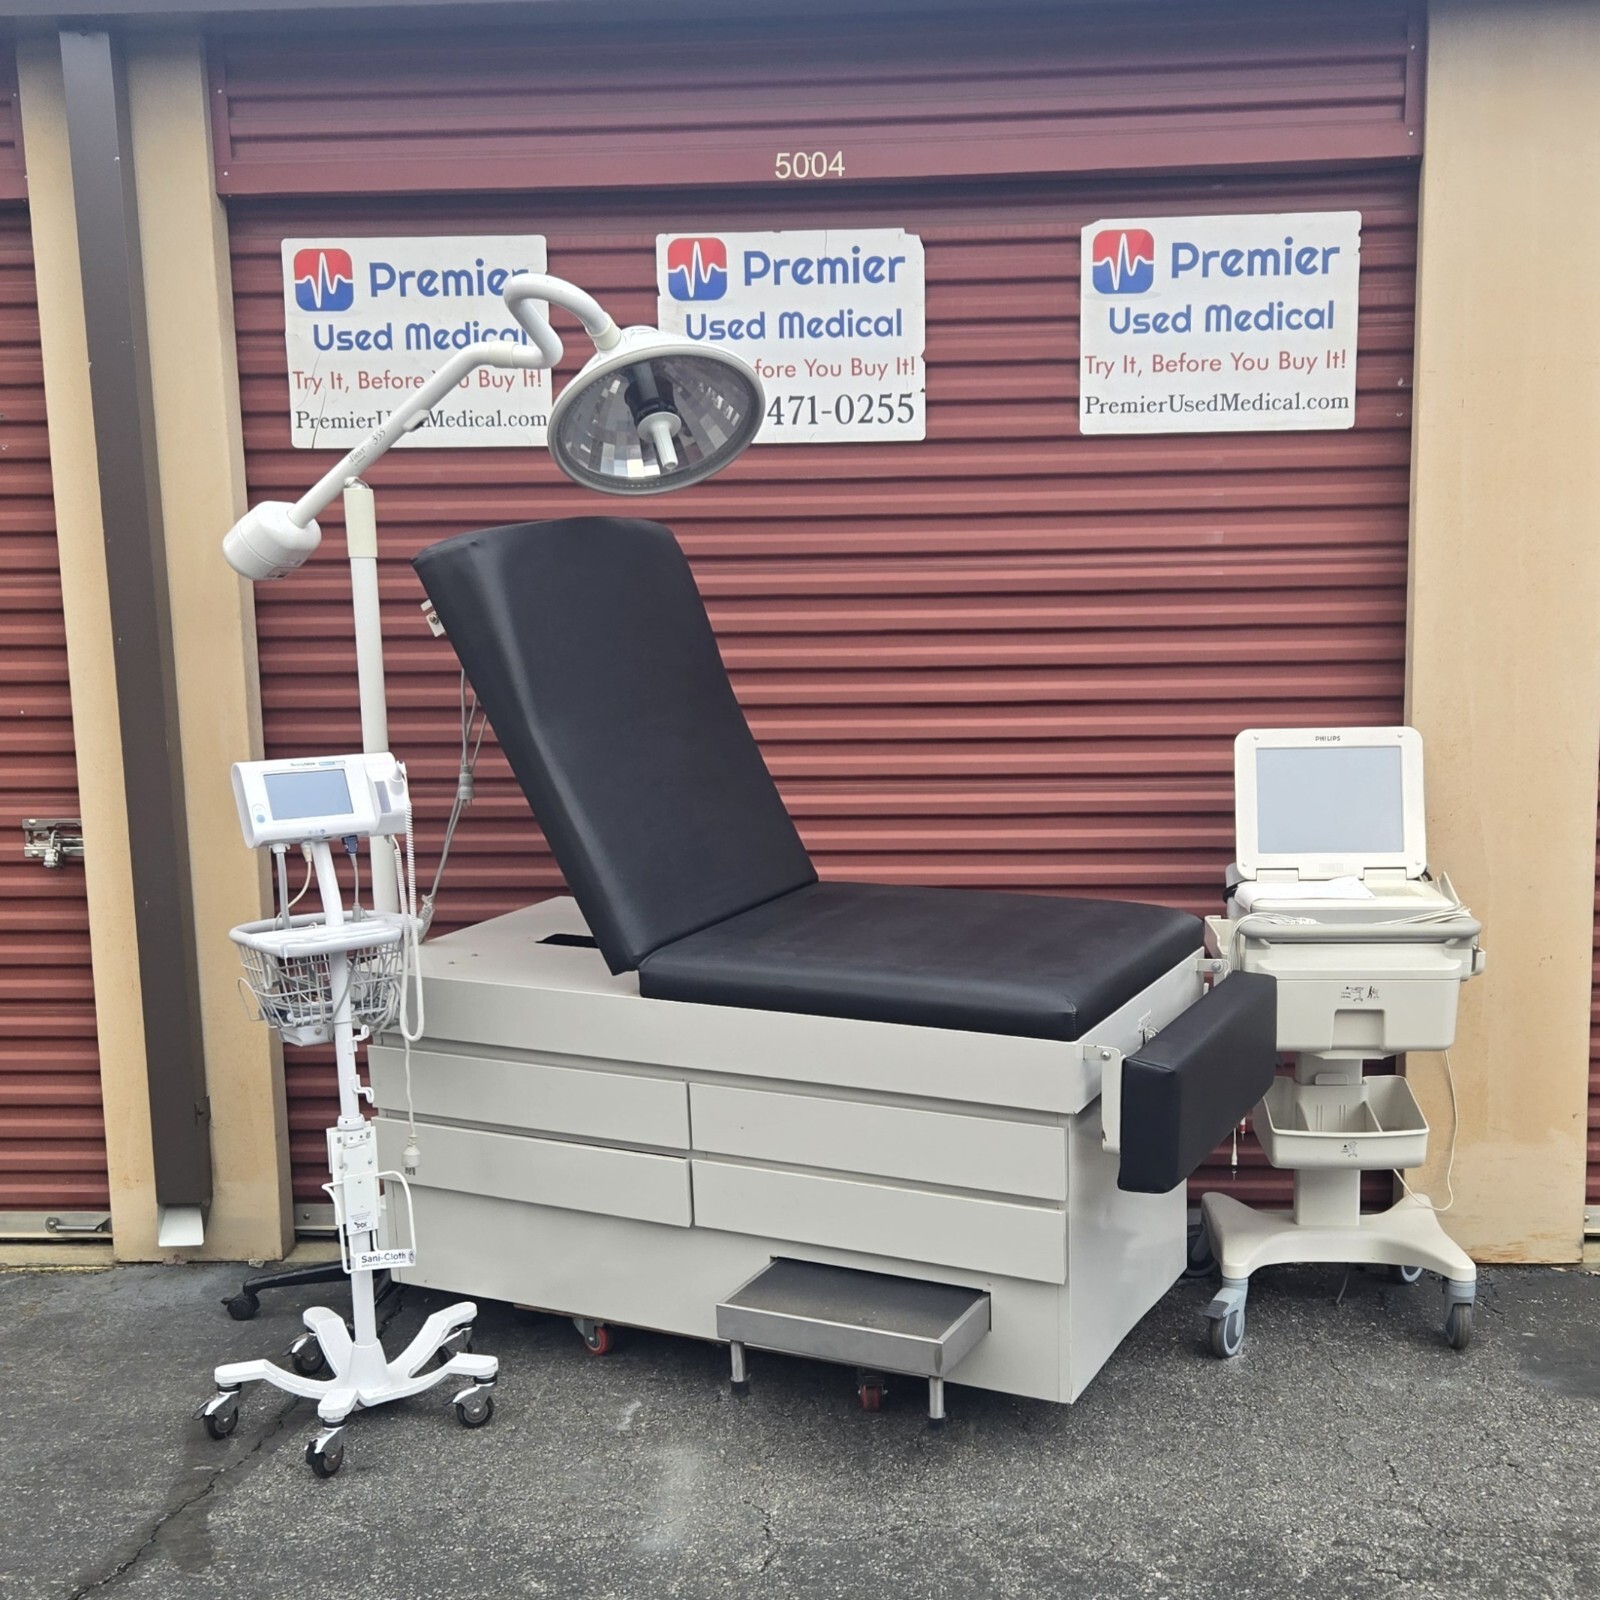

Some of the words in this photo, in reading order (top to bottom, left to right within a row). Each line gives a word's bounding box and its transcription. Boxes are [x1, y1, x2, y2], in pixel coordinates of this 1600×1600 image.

[775, 151, 845, 179] 5004
[744, 245, 905, 286] Premier
[1171, 236, 1340, 279] Premier
[686, 311, 765, 341] Used
[778, 308, 902, 339] Medical
[1109, 304, 1192, 334] Used
[1205, 300, 1334, 332] Medical
[313, 322, 393, 351] Used
[754, 358, 796, 378] fore
[804, 358, 842, 377] You
[851, 357, 888, 381] Buy
[896, 356, 915, 376] It!
[1085, 355, 1115, 379] Try
[1123, 355, 1142, 377] It,
[1152, 353, 1222, 373] Before
[1231, 352, 1269, 371] You
[1279, 351, 1318, 374] Buy
[1326, 349, 1346, 369] It!
[293, 371, 322, 394] Try
[331, 371, 349, 393] It,
[358, 370, 425, 389] Before
[479, 369, 515, 392] Buy
[523, 368, 542, 387] It!
[1085, 393, 1349, 414] PremierUsedMedical.com
[361, 1252, 406, 1264] Sani-Cloth
